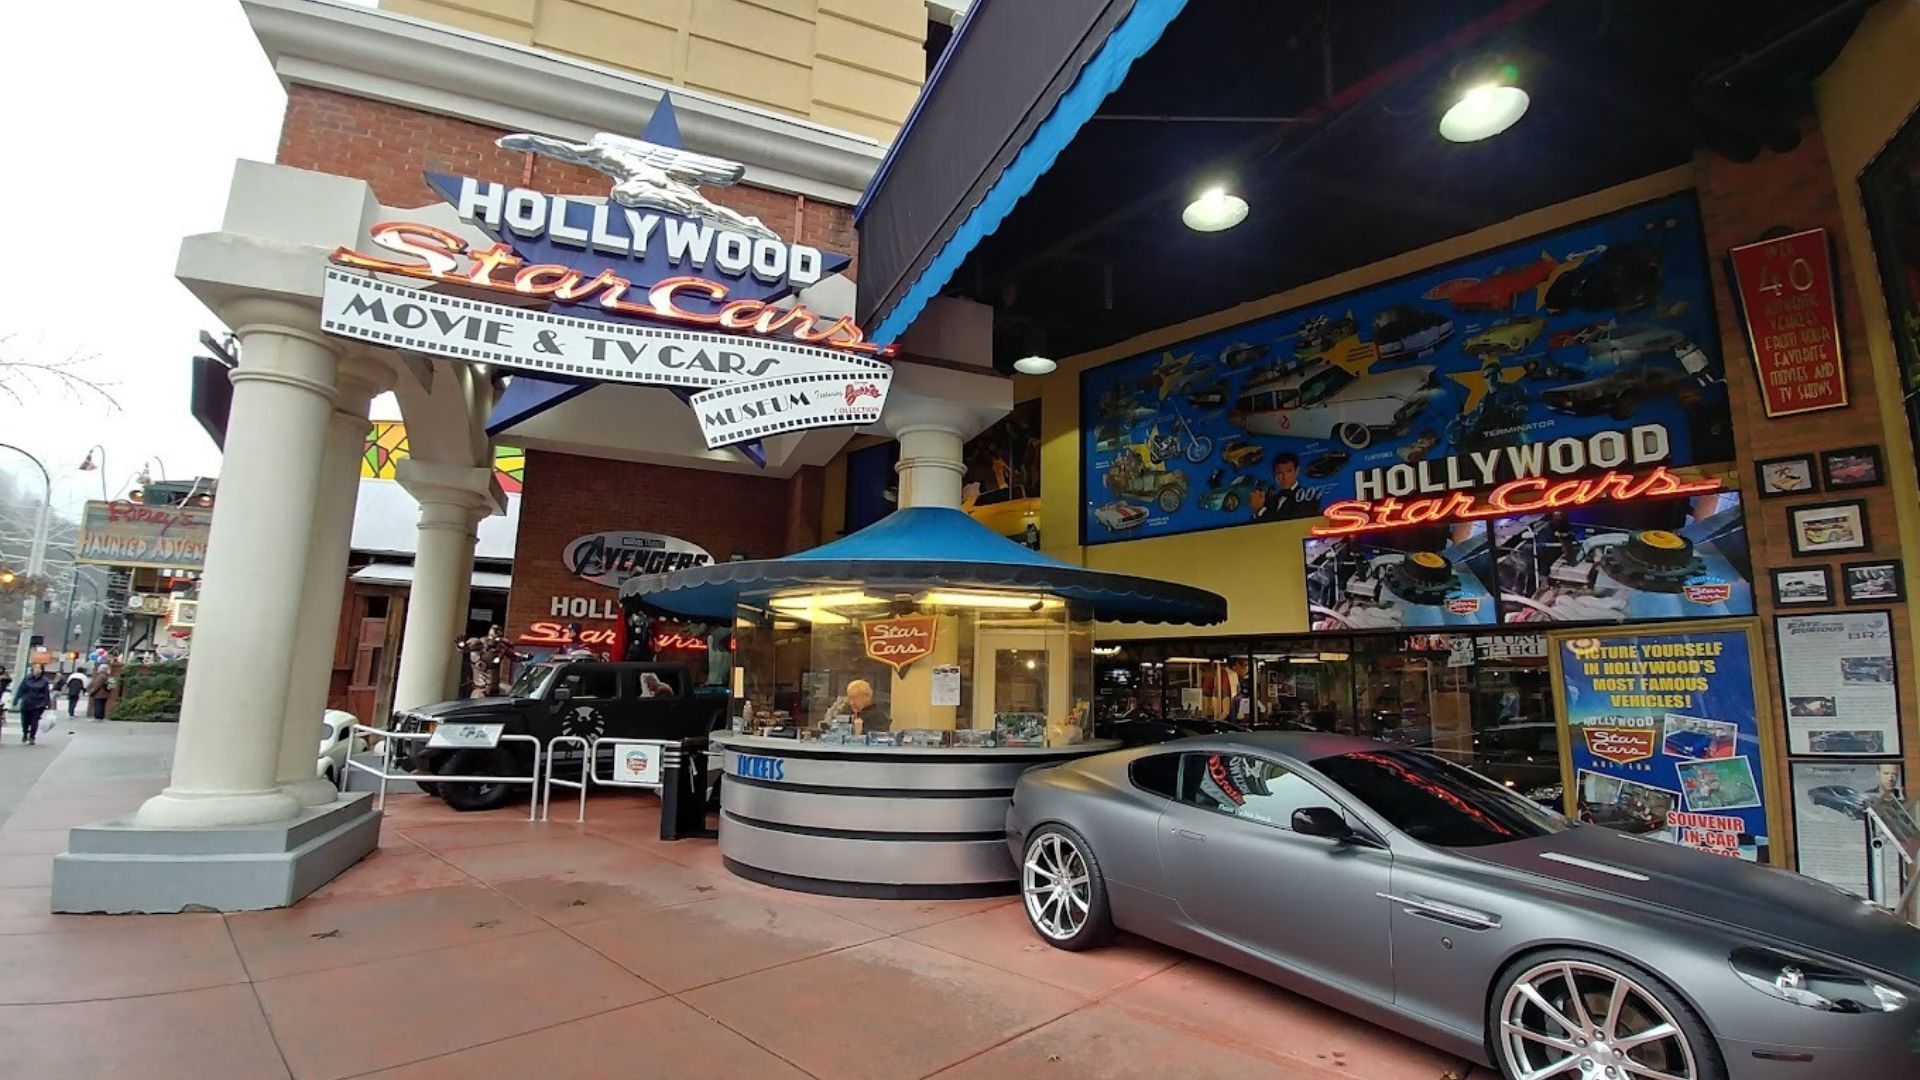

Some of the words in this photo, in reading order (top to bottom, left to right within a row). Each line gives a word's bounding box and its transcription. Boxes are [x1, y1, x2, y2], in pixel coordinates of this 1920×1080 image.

[460, 177, 822, 288] HOLLYWOOD
[329, 220, 634, 310] Star
[648, 277, 900, 357] Cars
[342, 293, 514, 349] MOVIE
[533, 329, 567, 358] &
[585, 335, 650, 368] TV
[658, 345, 781, 378] CARS
[1774, 345, 1828, 368] FAVORITE
[1770, 365, 1808, 387] MOVIES
[1815, 362, 1835, 379] AND
[1779, 387, 1793, 403] TV
[1798, 381, 1833, 400] SHOWS
[705, 391, 811, 430] MUSEUM
[834, 406, 879, 415] COLLECTION
[1482, 419, 1555, 439] TERMINATOR
[1355, 423, 1670, 501] HOLLYWOOD
[1296, 483, 1336, 503] 007
[1310, 489, 1480, 537] Star
[1487, 466, 1721, 513] Cars
[82, 532, 147, 560] HAUNTED
[153, 537, 207, 560] ADVEN
[551, 596, 618, 620] HOLL
[869, 624, 928, 640] Star
[1790, 627, 1845, 635] FURIOUS
[869, 641, 926, 655] Cars
[1575, 645, 1637, 660] PICTURE
[1642, 642, 1723, 658] YOURSELF
[1584, 663, 1599, 675] IN
[1604, 660, 1716, 675] HOLLYWOOD'S
[1593, 678, 1635, 691] MOST
[1640, 677, 1709, 691] FAMOUS
[1610, 695, 1692, 709] VEHICLES!
[1583, 716, 1654, 727] HOLLYWOOD
[1591, 732, 1648, 744] Star
[1592, 743, 1647, 755] Cars
[736, 753, 784, 781] TICKETS
[1666, 811, 1745, 833] SOUVENIR
[1683, 830, 1738, 847] IN-CAR
